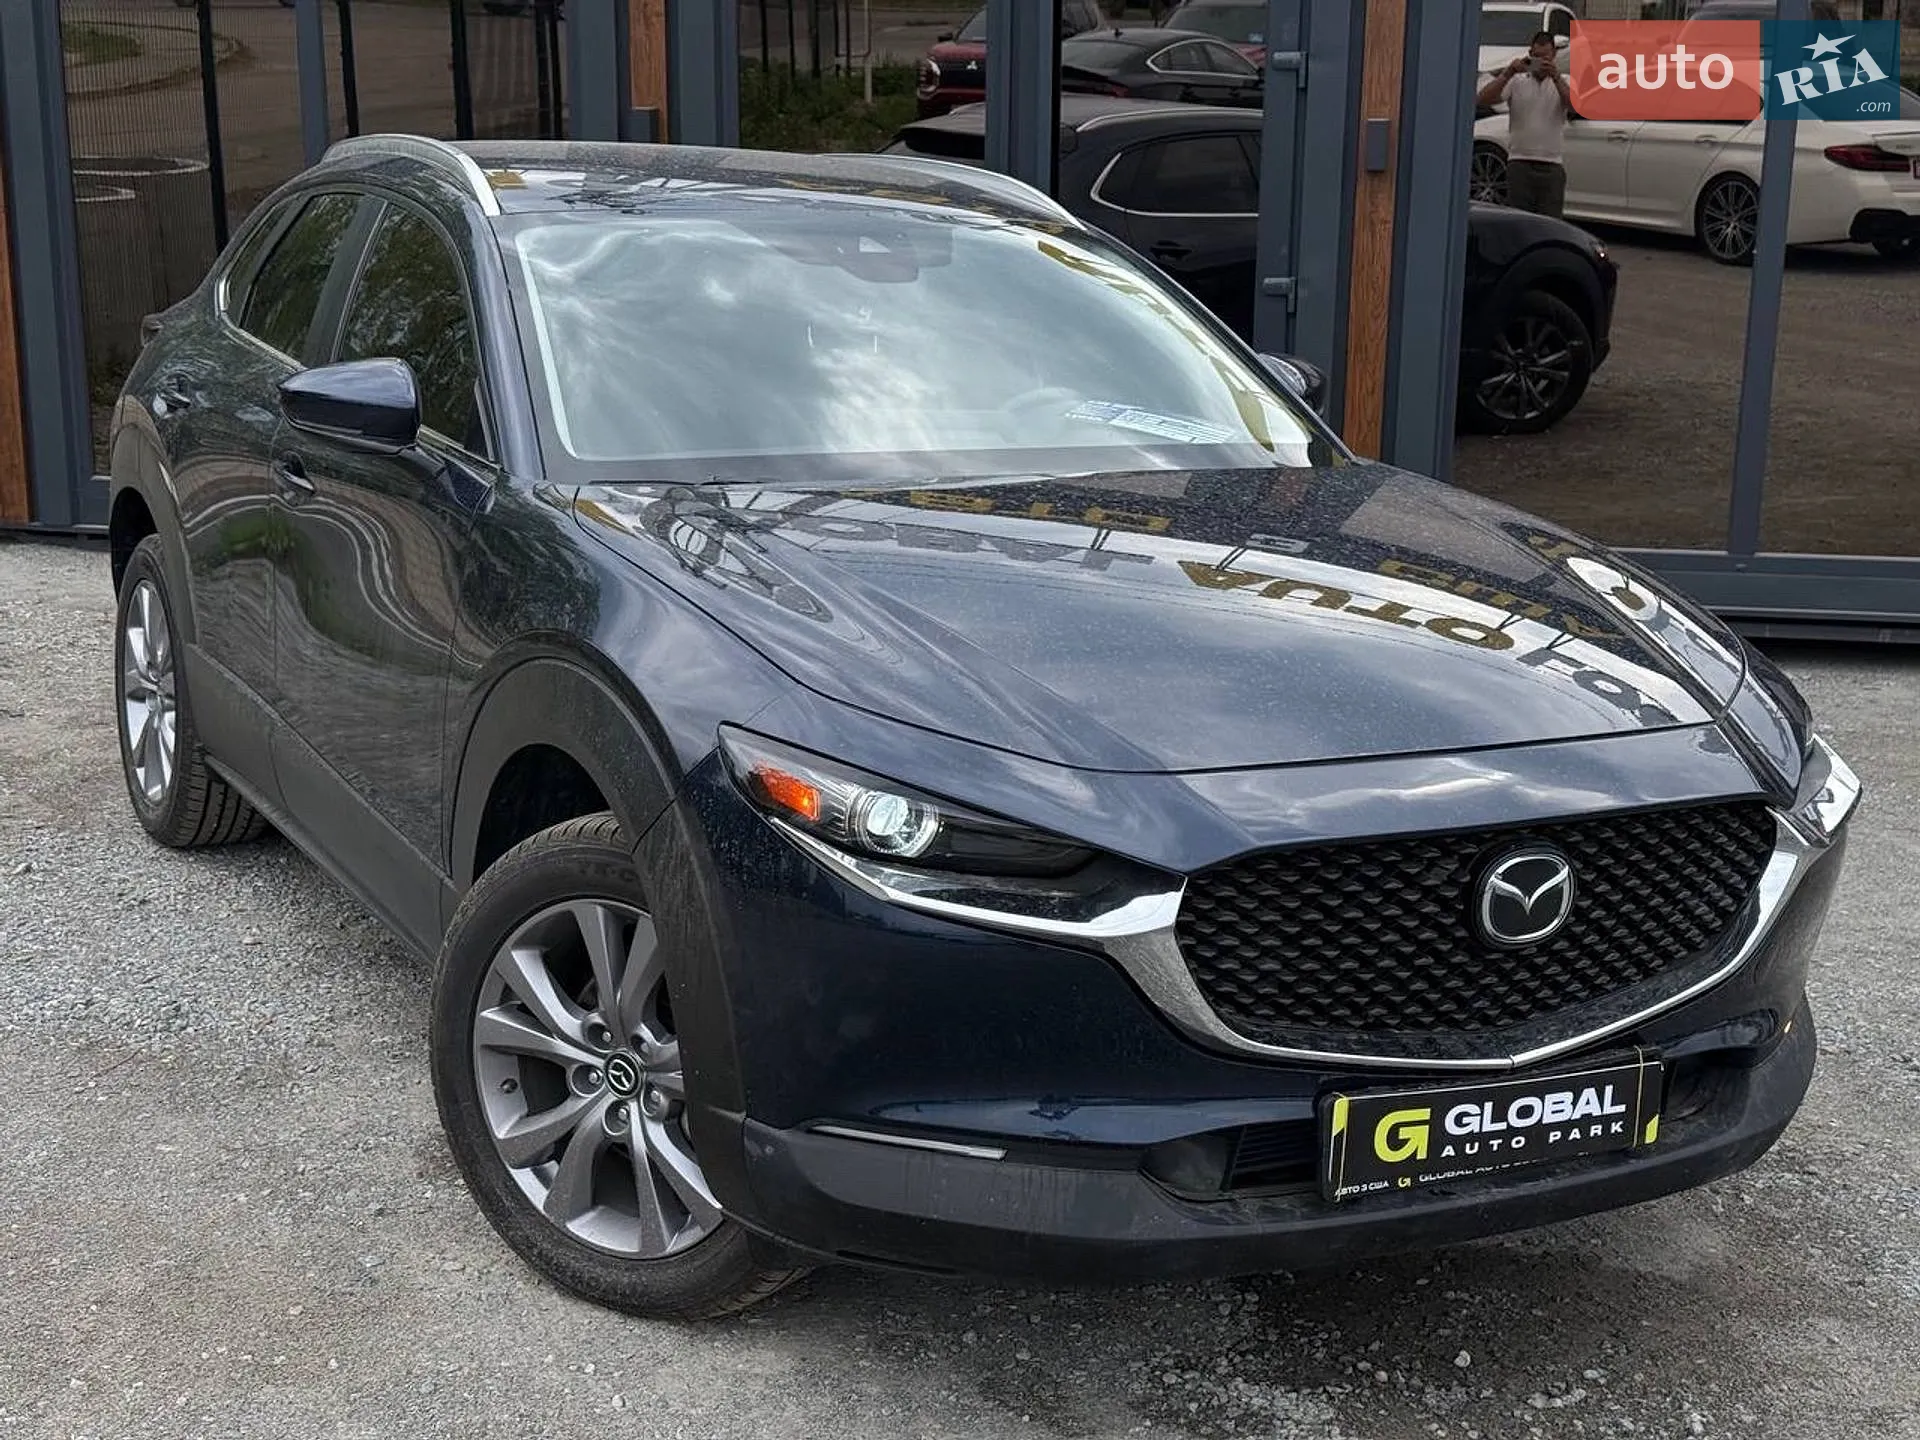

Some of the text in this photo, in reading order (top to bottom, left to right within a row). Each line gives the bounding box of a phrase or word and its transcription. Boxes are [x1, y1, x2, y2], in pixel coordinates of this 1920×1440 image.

[1444, 1084, 1627, 1136] GLOBAL
[1440, 1120, 1625, 1158] AUTO PARK
